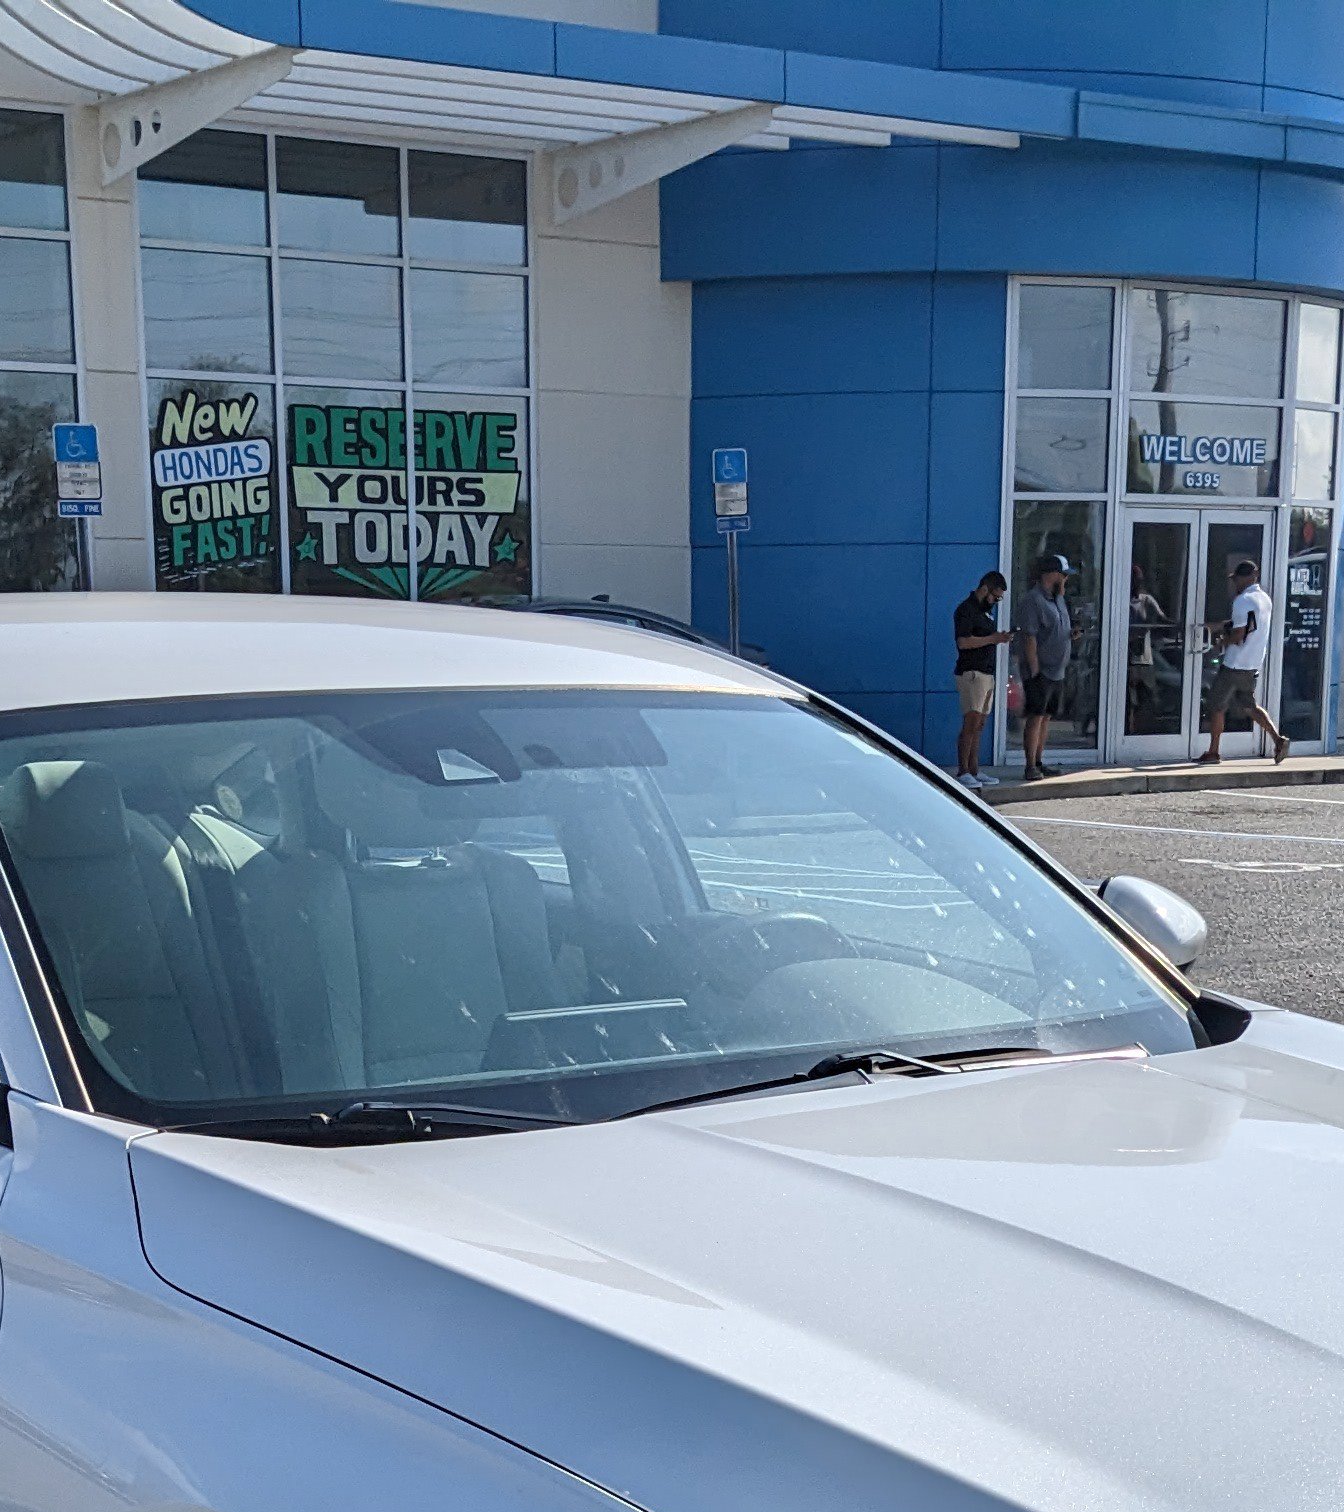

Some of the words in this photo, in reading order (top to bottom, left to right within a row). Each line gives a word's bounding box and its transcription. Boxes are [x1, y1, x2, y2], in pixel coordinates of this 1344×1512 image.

[161, 392, 256, 446] New
[294, 406, 518, 471] RESERVE
[160, 444, 263, 482] HONDAS
[1140, 435, 1267, 466] WELCOME
[161, 476, 271, 524] GOING
[314, 472, 486, 507] YOURS
[1185, 472, 1221, 488] 6395
[172, 514, 271, 567] FAST!
[307, 511, 500, 568] TODAY
